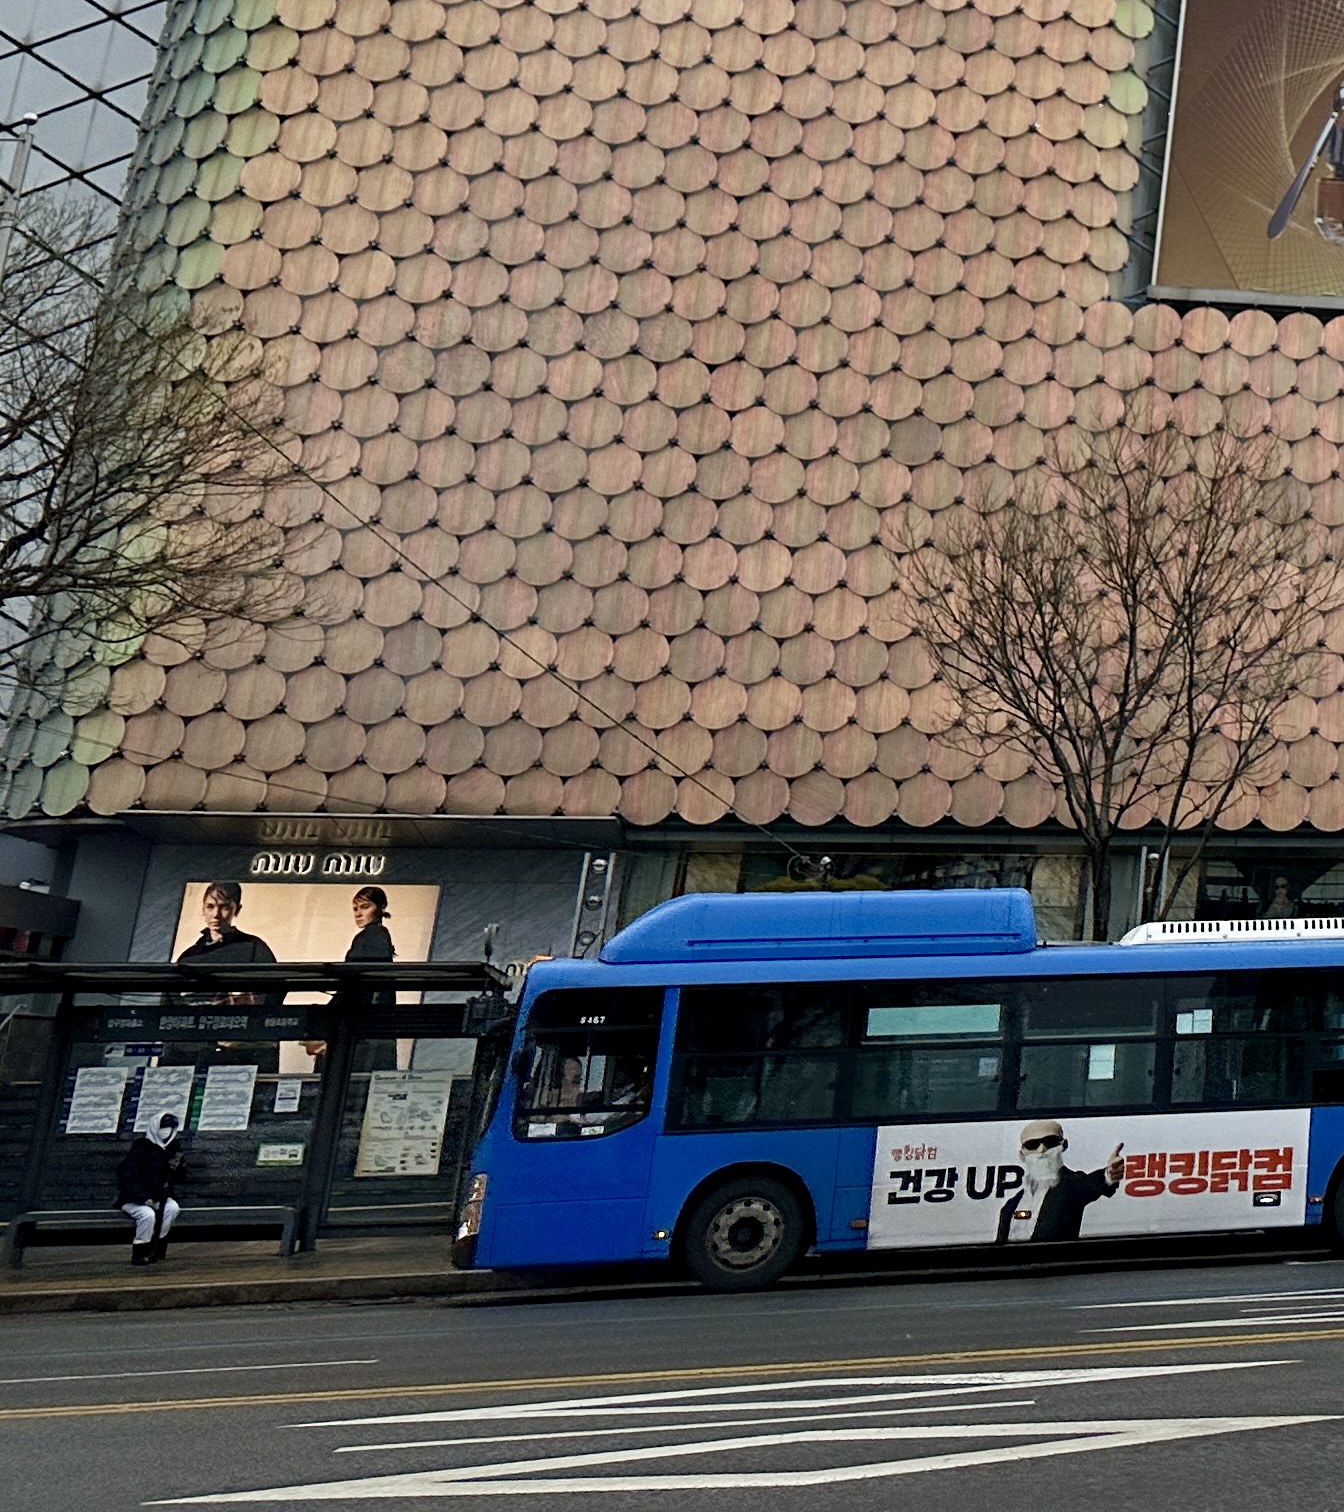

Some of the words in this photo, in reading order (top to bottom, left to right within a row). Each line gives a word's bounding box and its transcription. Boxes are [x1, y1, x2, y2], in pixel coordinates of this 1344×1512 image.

[888, 1167, 959, 1205] 건강
[966, 1164, 1025, 1200] UP
[1124, 1147, 1294, 1197] 랭킹닭컴
